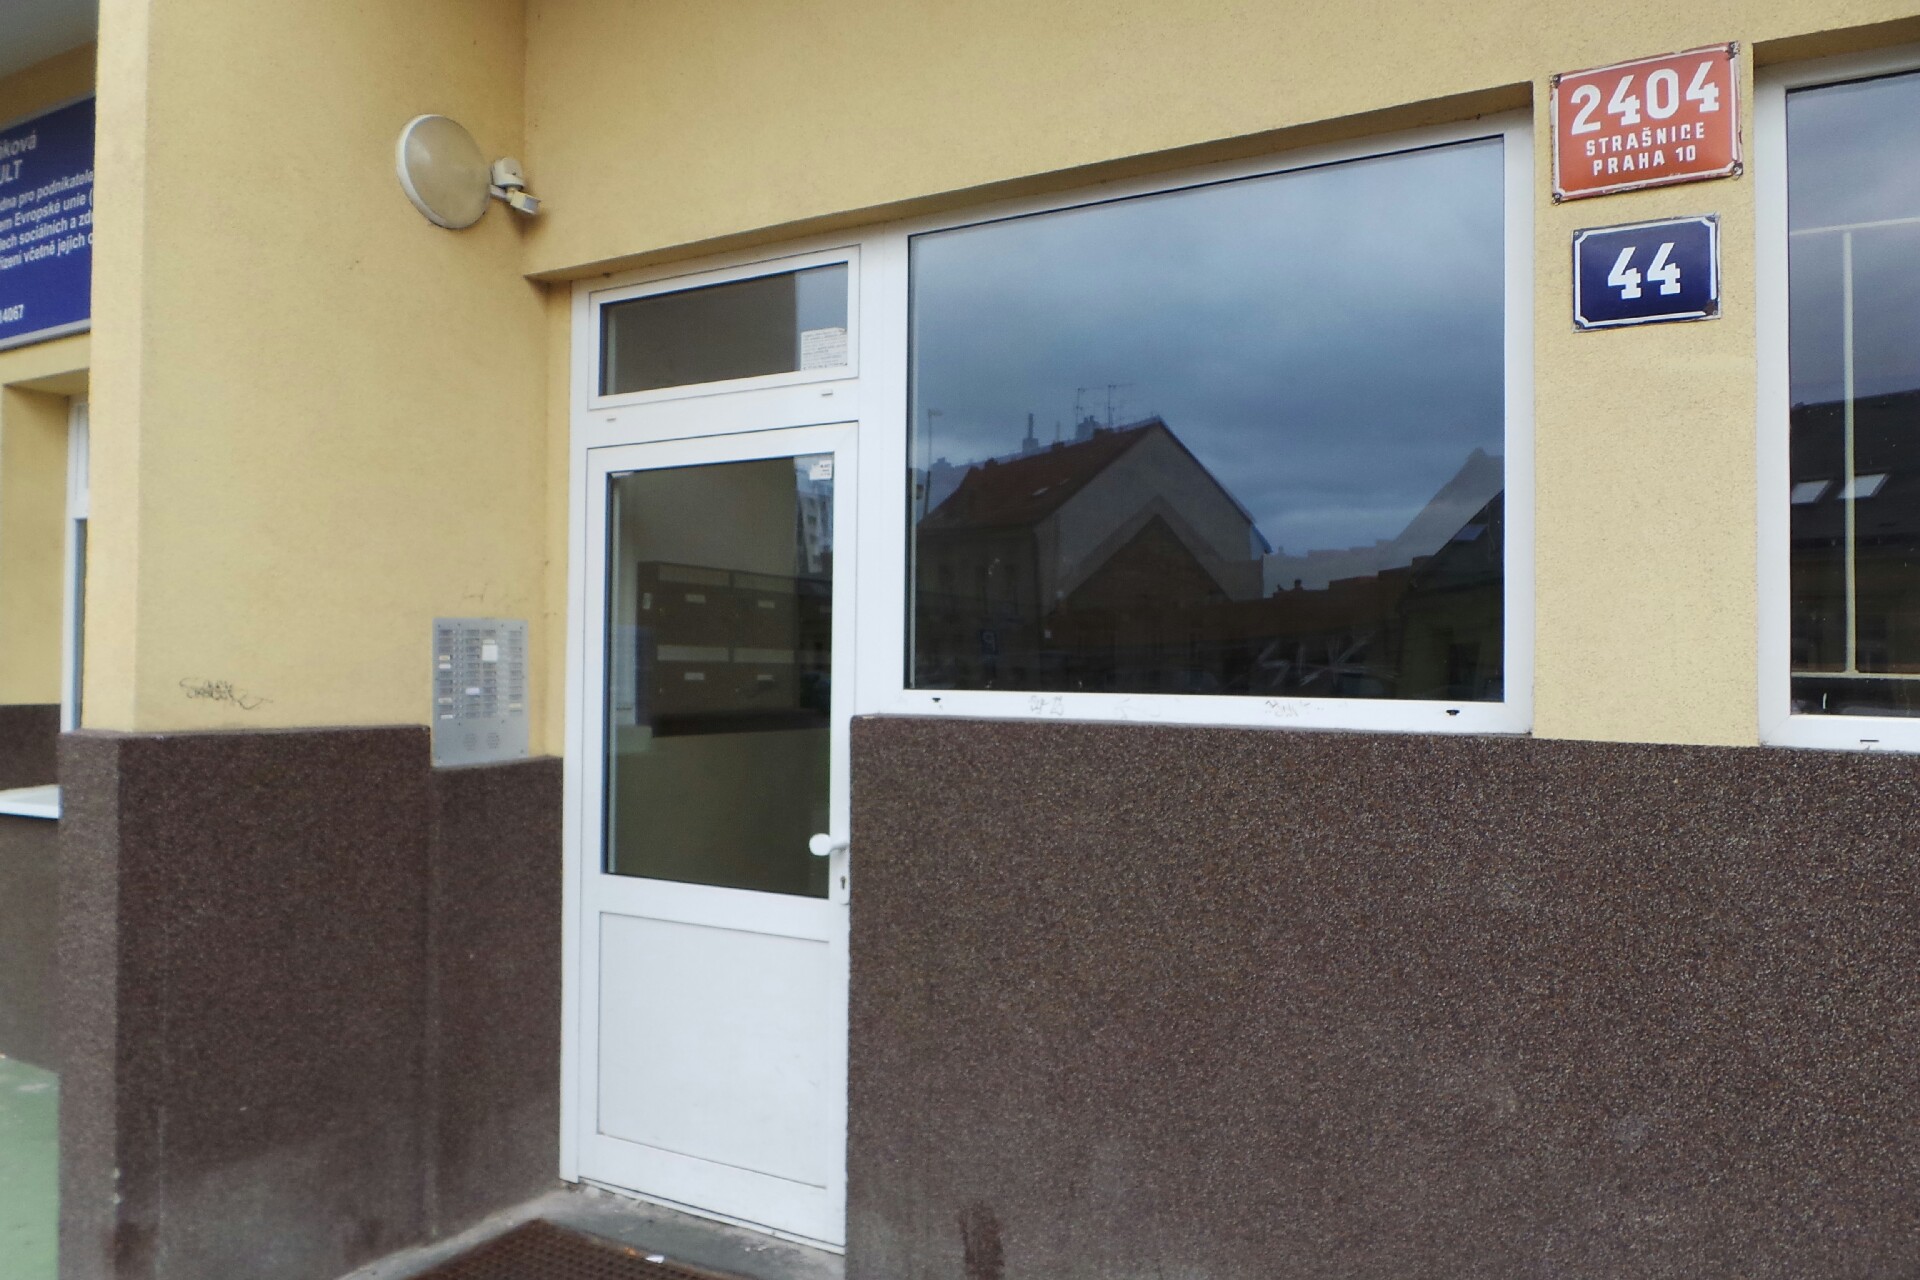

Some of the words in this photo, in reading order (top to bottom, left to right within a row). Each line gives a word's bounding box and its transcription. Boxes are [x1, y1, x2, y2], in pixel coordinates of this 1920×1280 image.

[1570, 61, 1720, 136] 2404
[1585, 121, 1705, 157] STRAŠNICE
[1593, 149, 1665, 176] PRAHA
[1675, 145, 1696, 163] 10
[14, 198, 60, 226] Evropské
[63, 192, 86, 211] unie
[18, 190, 35, 207] pro
[70, 217, 77, 229] a
[57, 232, 85, 257] jejich
[1608, 242, 1681, 300] 44
